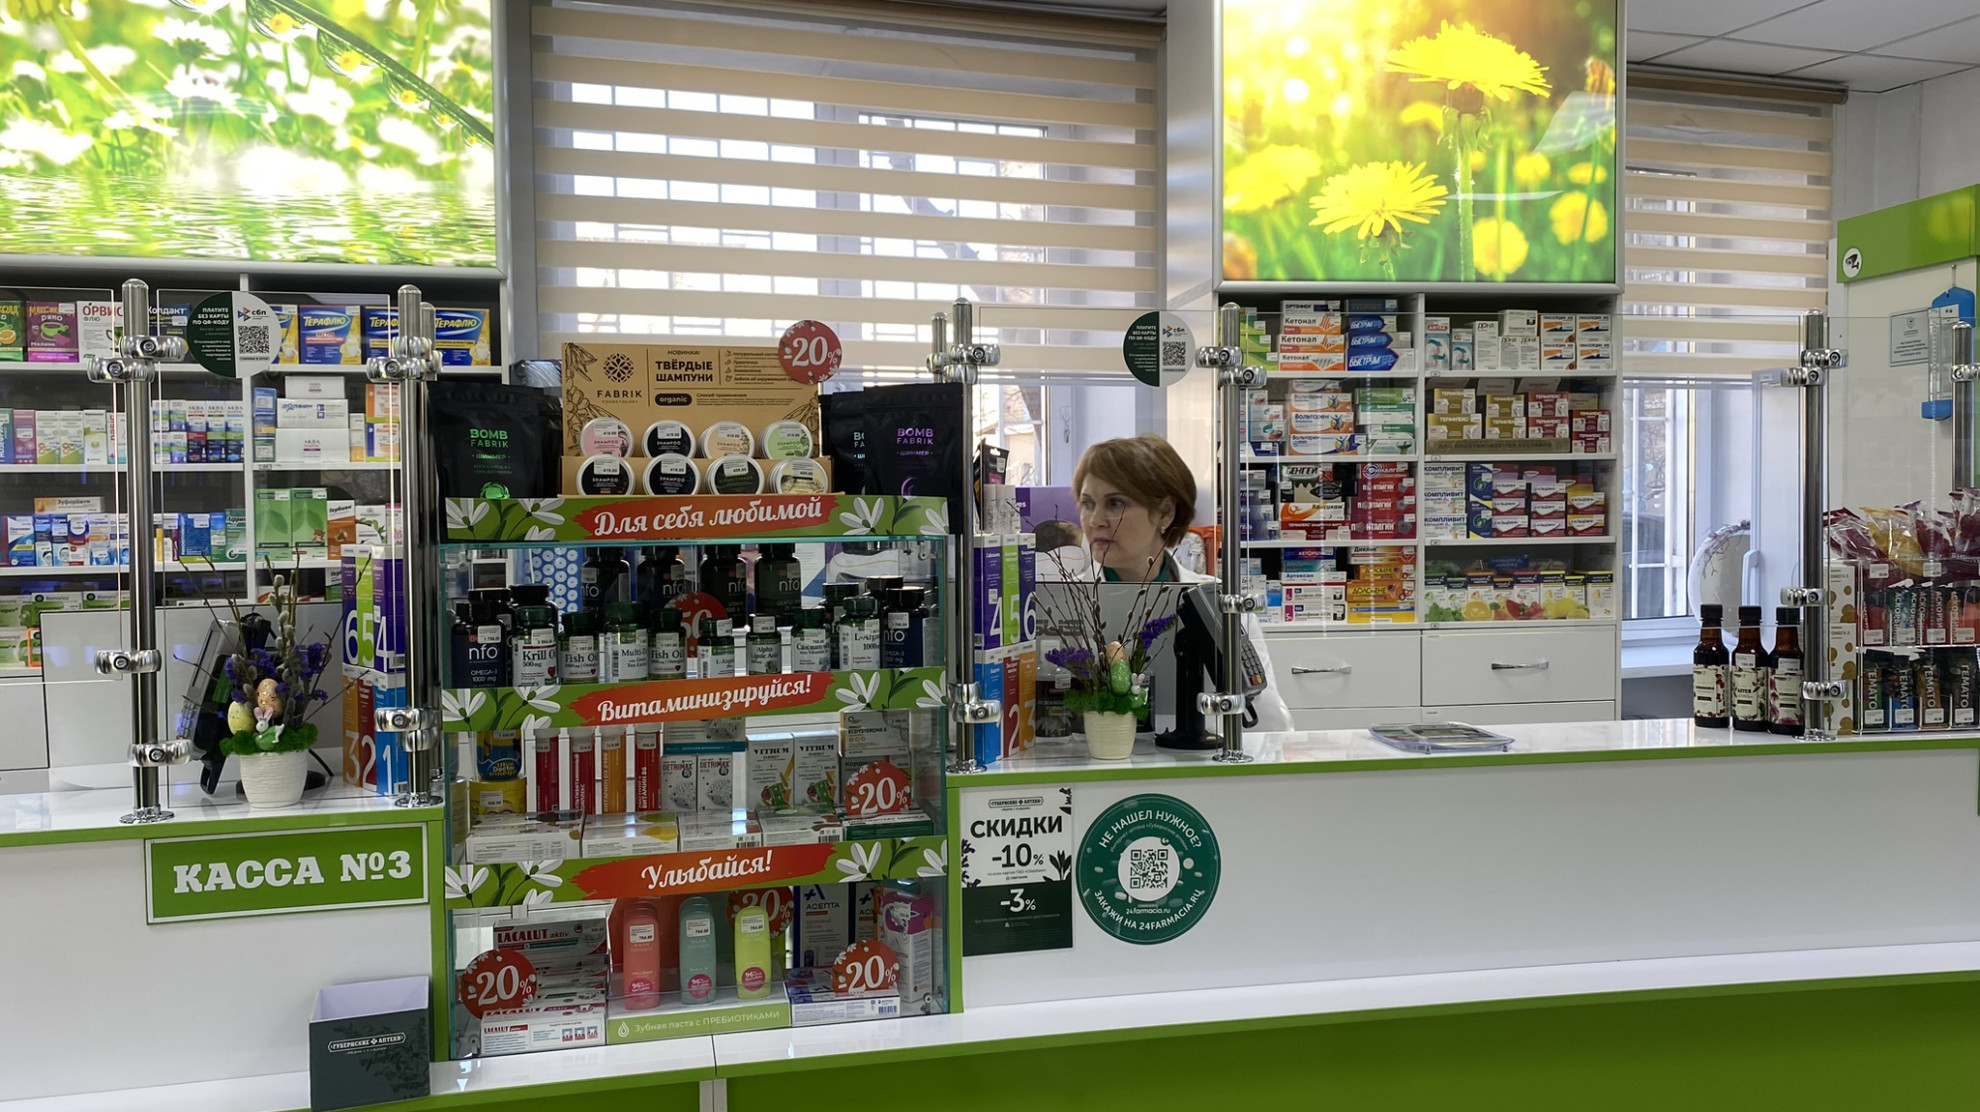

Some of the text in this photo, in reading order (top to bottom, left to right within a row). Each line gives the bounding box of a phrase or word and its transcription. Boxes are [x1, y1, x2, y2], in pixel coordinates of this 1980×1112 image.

[783, 335, 839, 369] -20%
[1281, 335, 1317, 343] Кетонал
[655, 358, 713, 372] ТВЁРДЫЕ
[655, 372, 713, 384] ШАМПУНИ
[597, 389, 643, 399] FABRIK
[659, 395, 688, 404] organic
[470, 428, 508, 440] BOMB
[470, 439, 509, 448] FABRIK
[896, 437, 934, 445] FABRIK
[897, 427, 934, 437] BOMB
[593, 496, 822, 536] Для себя любимой
[990, 596, 1003, 647] 4
[1010, 593, 1021, 644] 5
[1023, 591, 1037, 641] 6
[345, 609, 359, 665] 6
[362, 612, 374, 668] 5
[375, 615, 389, 673] 4
[468, 643, 498, 660] nfo
[522, 650, 547, 661] Krill
[565, 653, 584, 662] Fish
[651, 650, 669, 660] Fish
[597, 674, 812, 722] Витаминизируйся!
[1009, 703, 1020, 757] 2
[1024, 700, 1036, 749] 3
[345, 731, 360, 785] 3
[362, 734, 377, 790] 2
[753, 747, 789, 755] VITRUM
[799, 744, 834, 752] VITRUM
[382, 744, 393, 796] 1
[850, 776, 908, 818] -20%
[970, 815, 1063, 839] СКИДКИ
[1098, 810, 1202, 848] НЕ НАШЕЛ НУЖНОЕ?
[641, 849, 774, 889] Улыбайся!
[991, 843, 1045, 868] -10%
[173, 849, 412, 894] КАССА №3
[805, 901, 840, 910] АСЕПТА
[1000, 888, 1037, 913] -3%
[1095, 889, 1202, 930] ЗАКАЖИ НА 24FARMACIA.RU
[497, 928, 548, 944] LACALUT
[467, 964, 532, 1007] -20%
[837, 954, 897, 993] -20%
[634, 1022, 667, 1032] Зубная
[669, 1020, 694, 1029] паста
[702, 1010, 780, 1025] ПРЕБИОТИКАМИ
